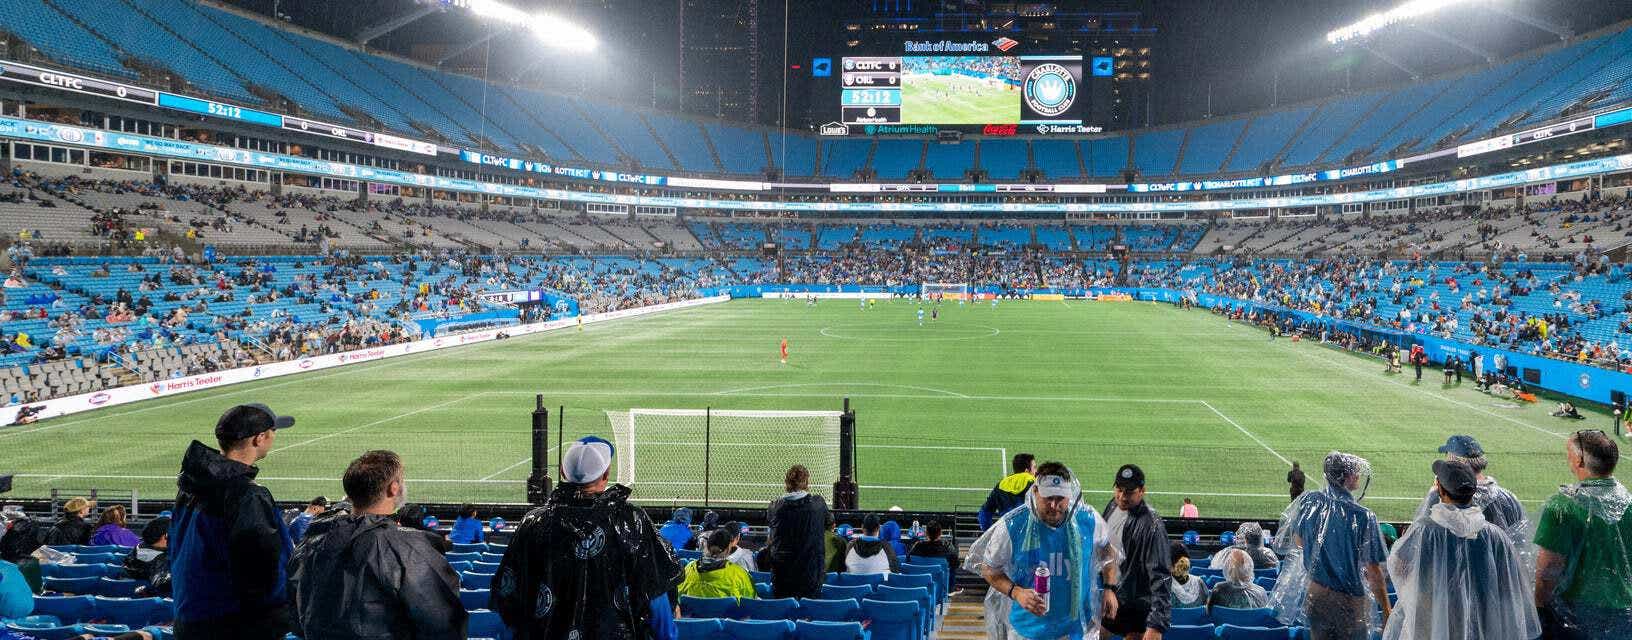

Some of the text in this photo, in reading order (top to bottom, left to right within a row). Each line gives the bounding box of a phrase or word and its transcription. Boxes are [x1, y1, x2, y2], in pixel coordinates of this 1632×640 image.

[904, 40, 989, 52] Bank of America
[889, 61, 896, 70] 0
[889, 75, 896, 84] 0
[1031, 65, 1071, 81] CHARLOTTE
[40, 72, 127, 98] CLTFC 0
[852, 91, 890, 104] 52:12
[208, 101, 241, 118] 52:12
[1031, 99, 1071, 114] FOOTBALL CLUB
[301, 121, 348, 137] 0 ORL
[877, 125, 938, 134] Atrium Health
[1050, 125, 1103, 133] Harris Teeter
[1569, 122, 1576, 132] 0
[167, 375, 223, 391] Harris Teeter
